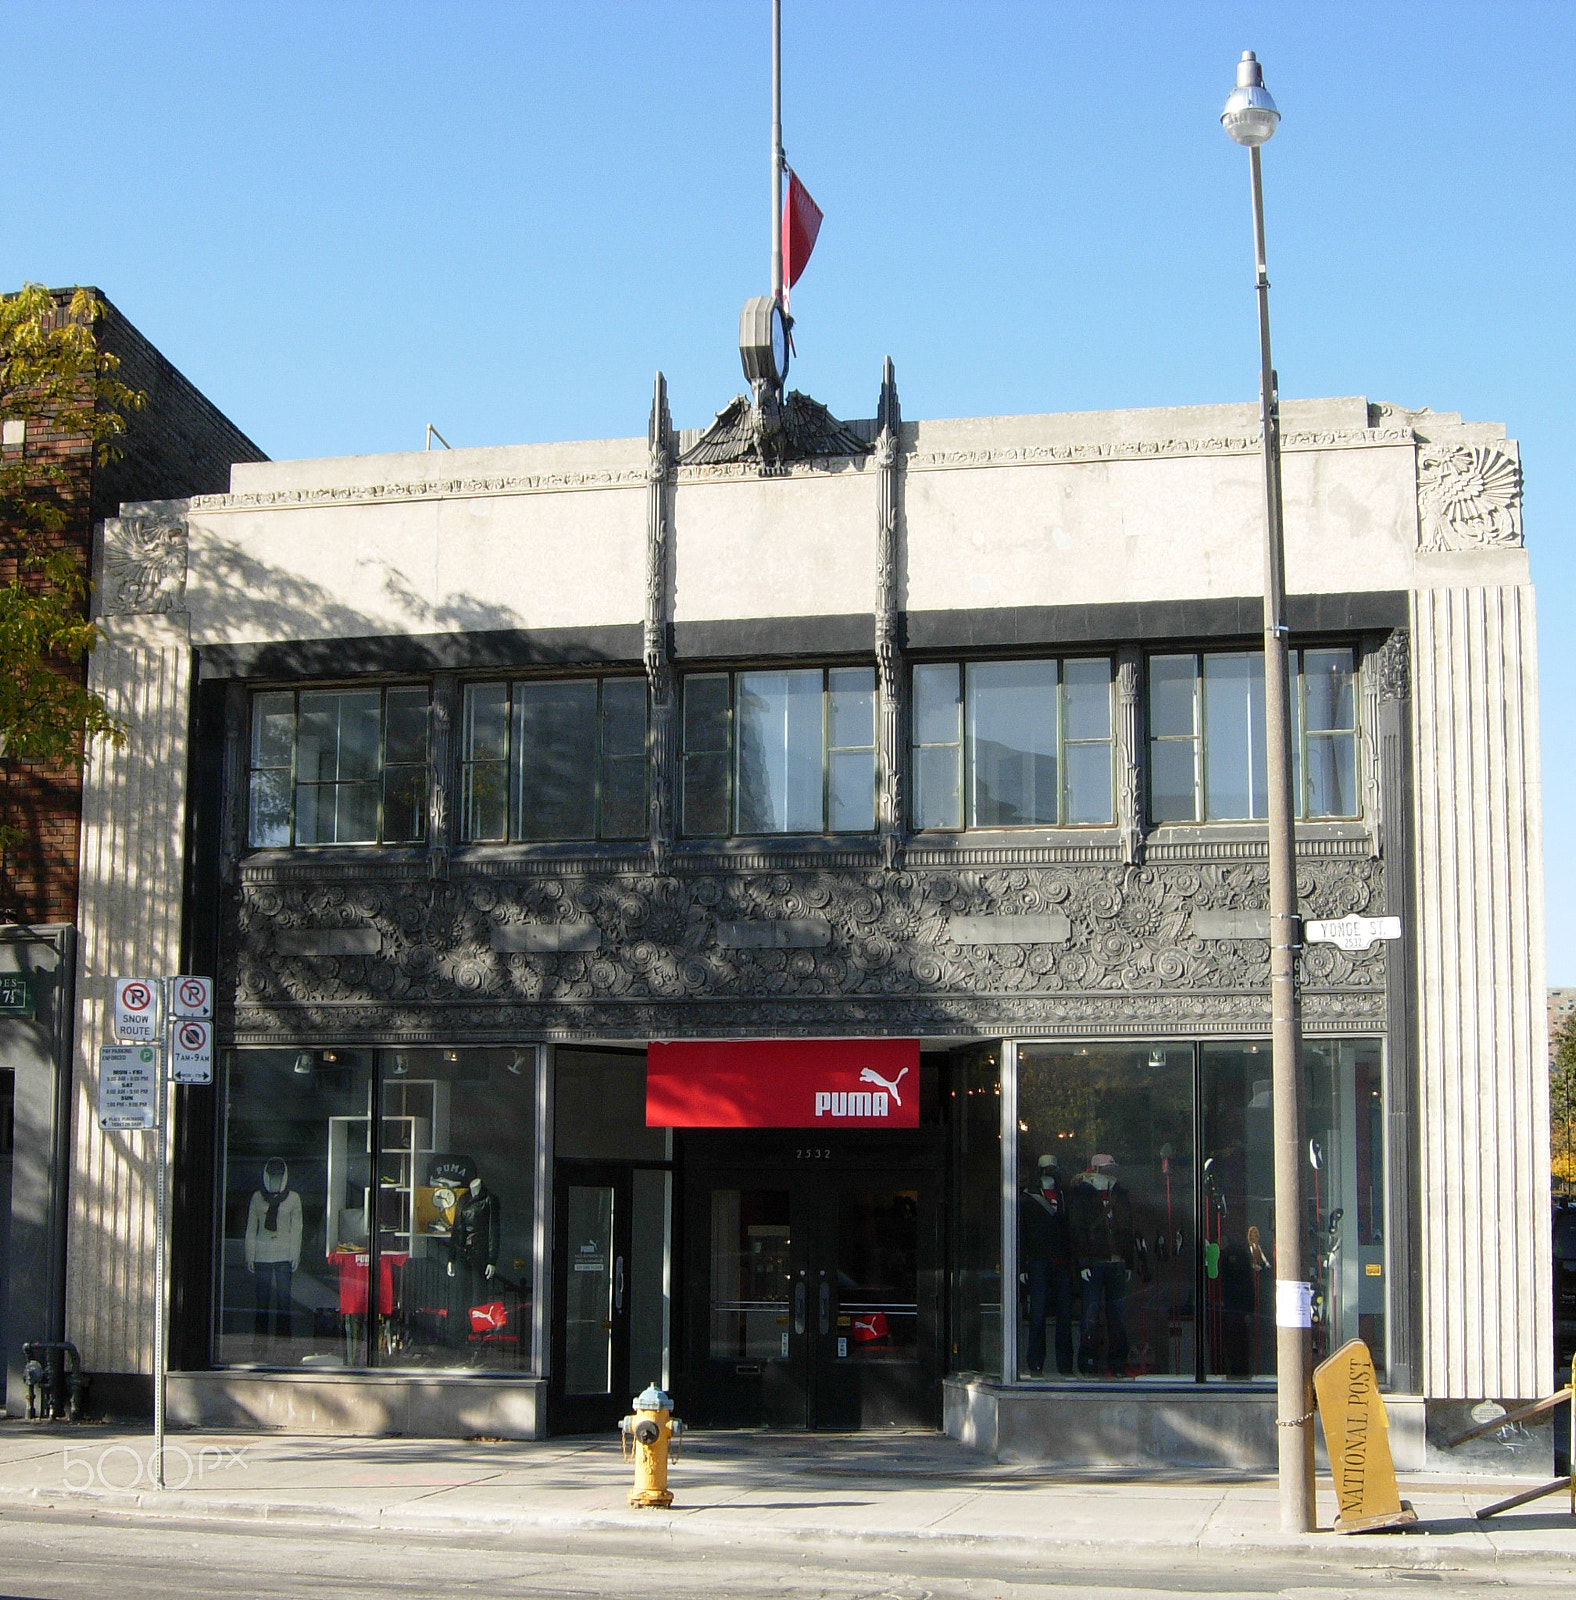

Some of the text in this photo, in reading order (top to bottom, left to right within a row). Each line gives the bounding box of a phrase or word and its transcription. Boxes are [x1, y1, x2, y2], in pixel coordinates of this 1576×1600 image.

[1320, 921, 1361, 938] YONGE
[1344, 938, 1362, 948] 2532
[122, 1014, 149, 1024] SNOW
[120, 1026, 151, 1036] ROUTE
[815, 1091, 889, 1117] PUMA
[796, 1149, 831, 1159] 2532
[436, 1163, 467, 1177] PUMA
[1341, 1358, 1372, 1514] NATIONAL POST
